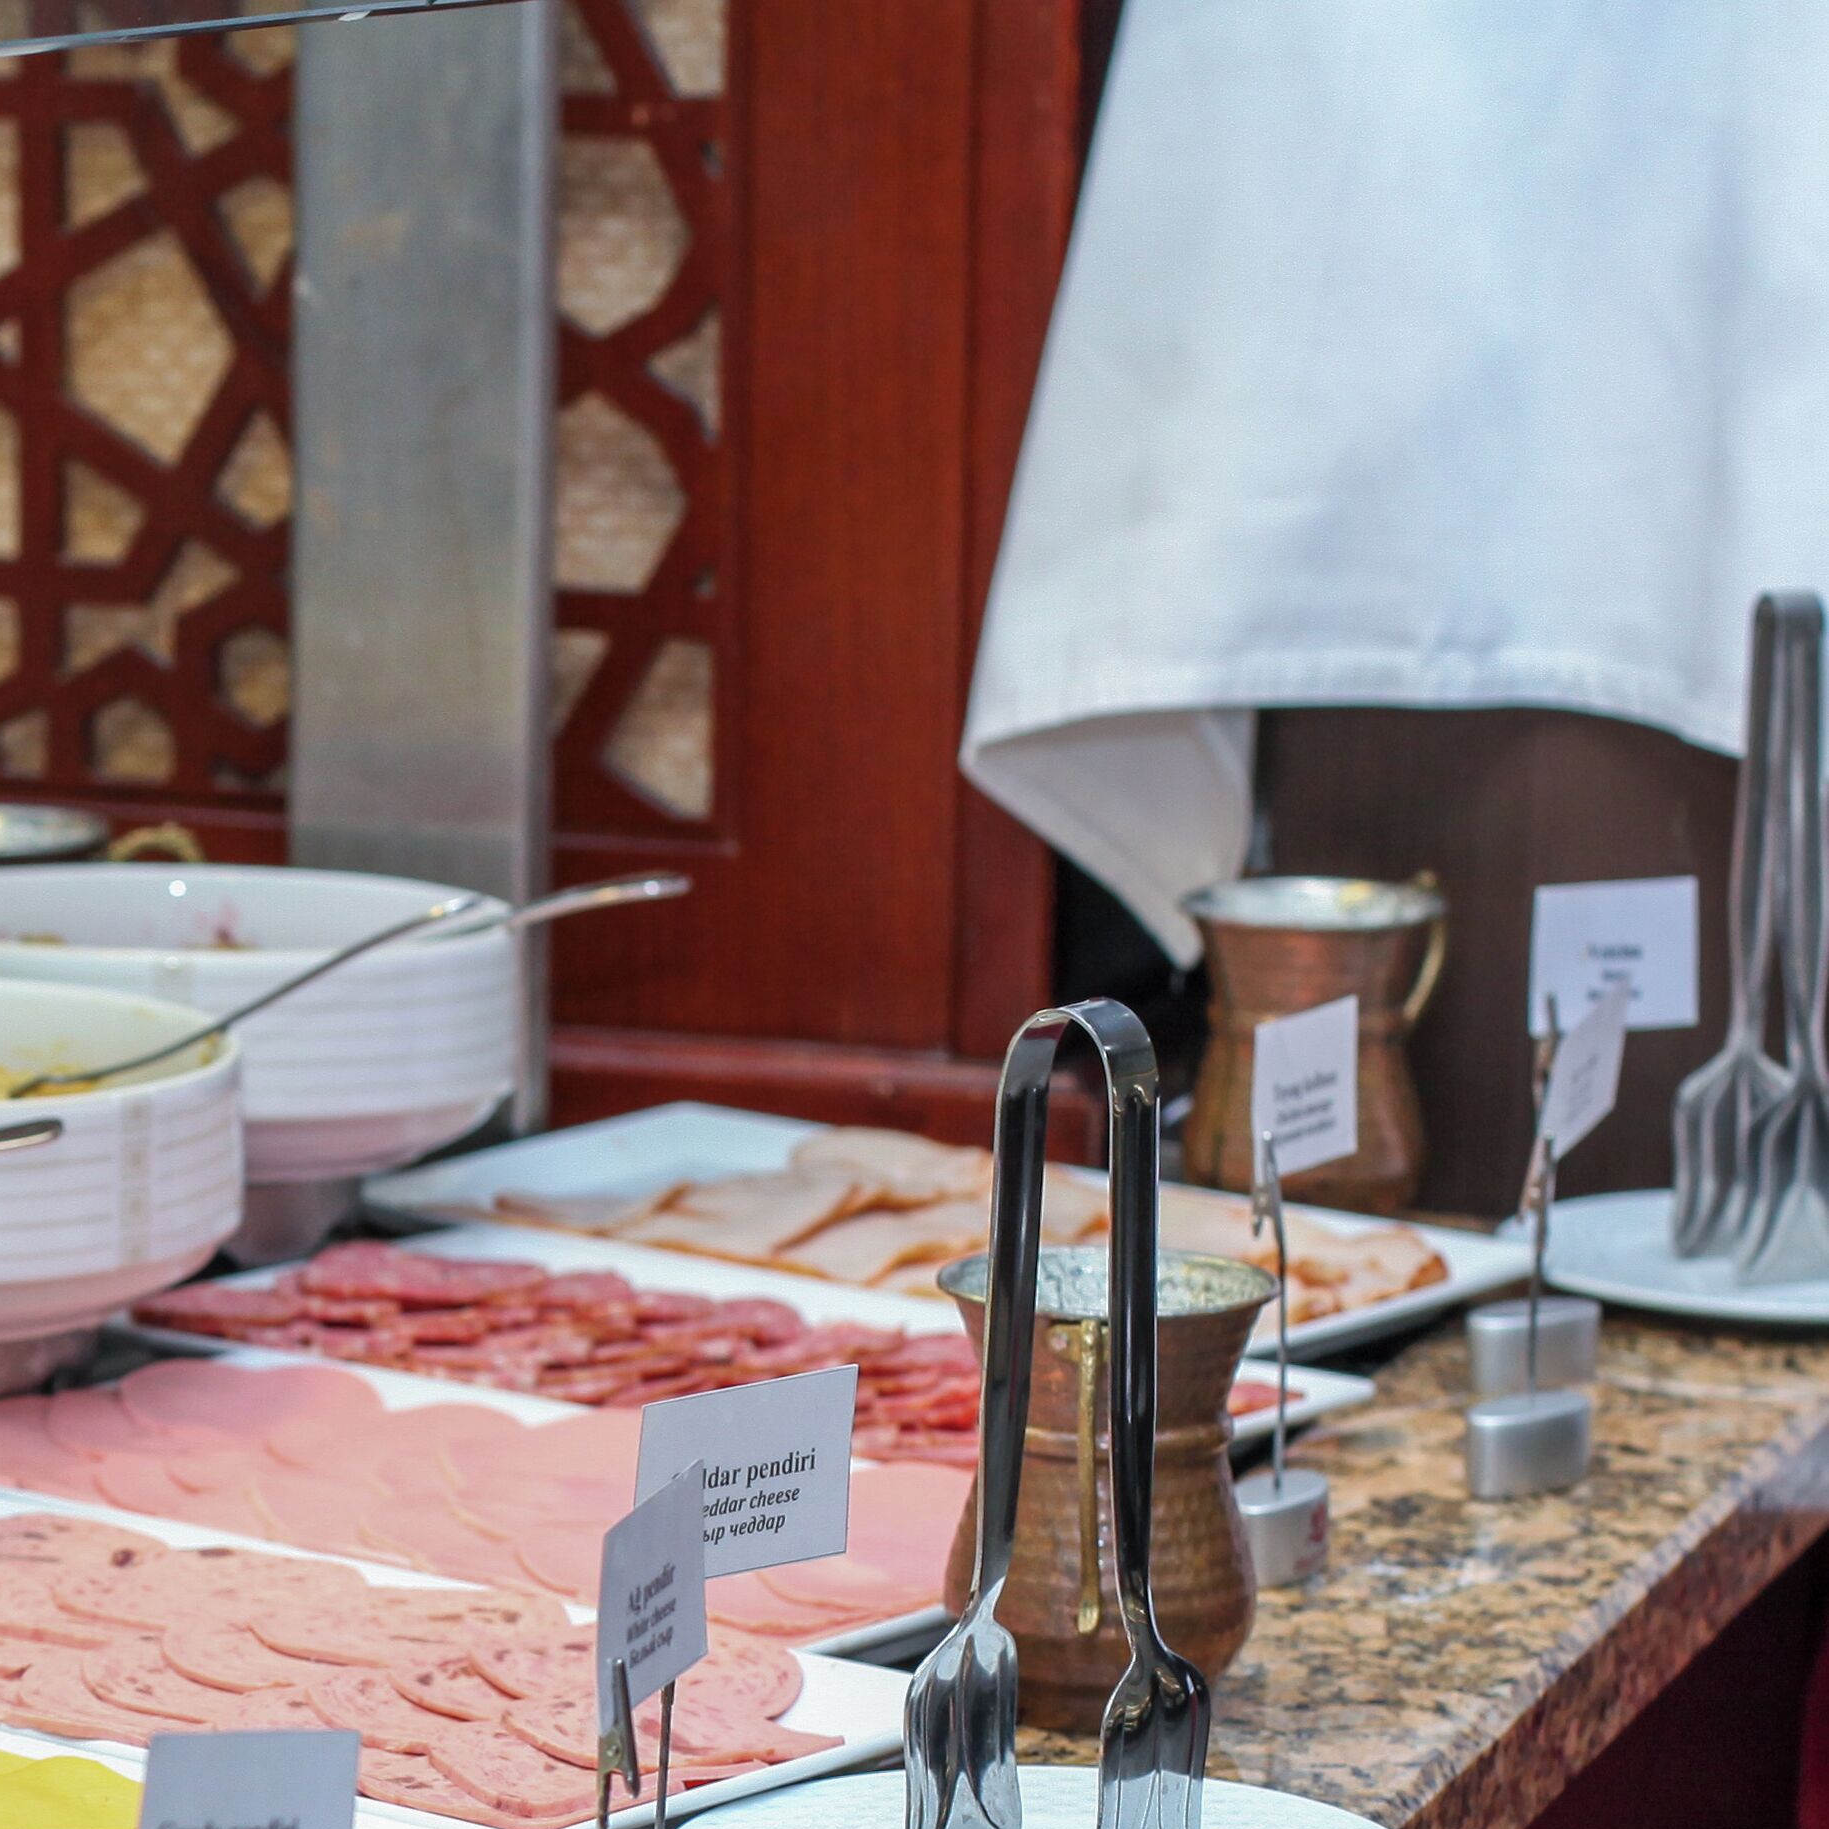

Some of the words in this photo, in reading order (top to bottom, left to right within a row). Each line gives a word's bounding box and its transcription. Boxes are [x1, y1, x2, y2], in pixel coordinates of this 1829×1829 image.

[746, 1448, 816, 1488] pendiri
[702, 1497, 746, 1519] eddar
[749, 1487, 801, 1509] cheese
[702, 1526, 725, 1545] ыр
[730, 1513, 786, 1537] чеддар
[627, 1618, 649, 1645] White
[650, 1598, 676, 1628] cheese
